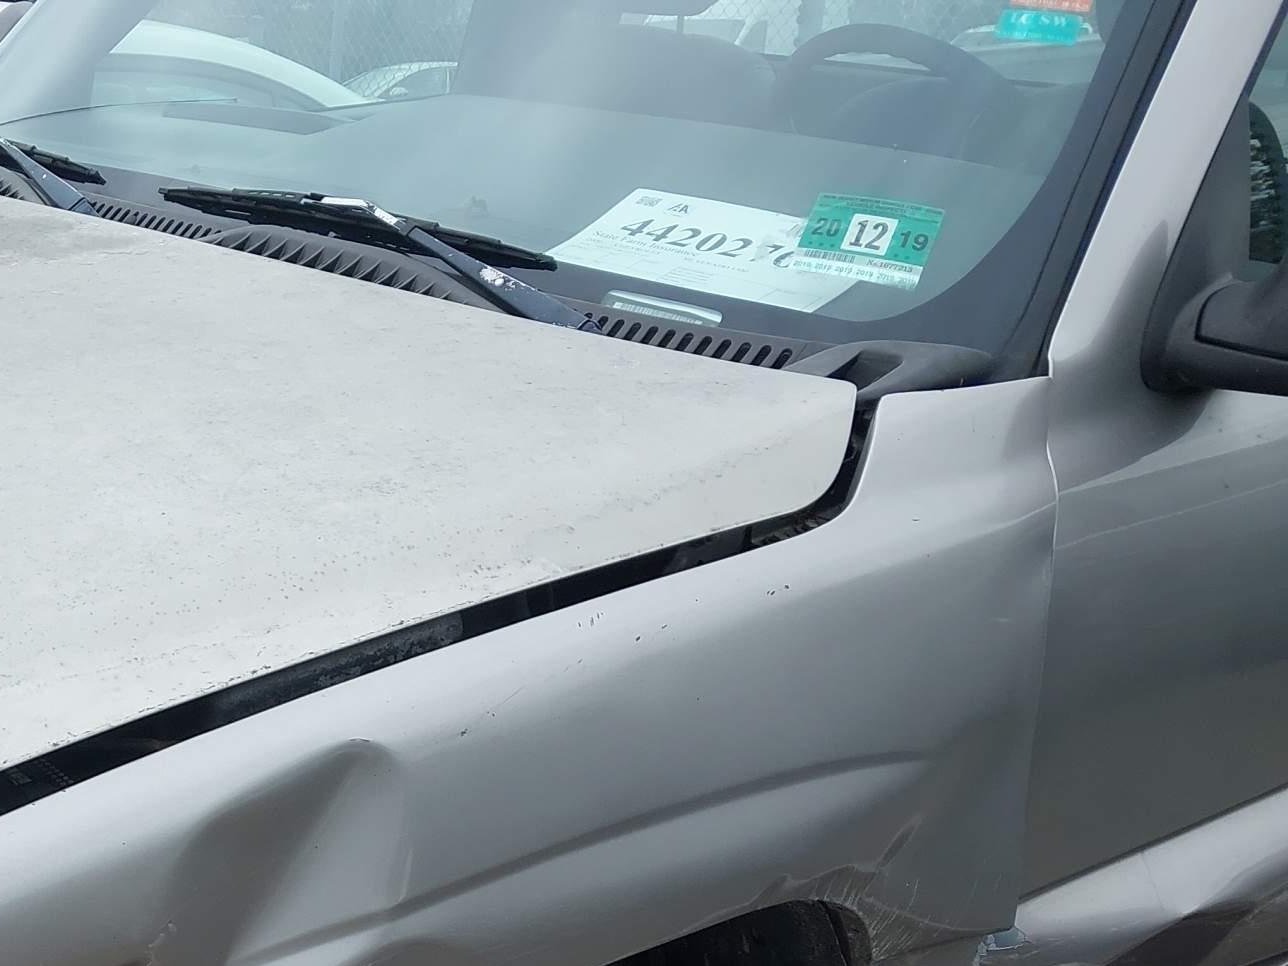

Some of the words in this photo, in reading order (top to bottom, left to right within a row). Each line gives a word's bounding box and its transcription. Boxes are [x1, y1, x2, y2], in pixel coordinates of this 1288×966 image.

[811, 217, 841, 237] 20
[849, 219, 889, 251] 12
[899, 230, 929, 251] 19
